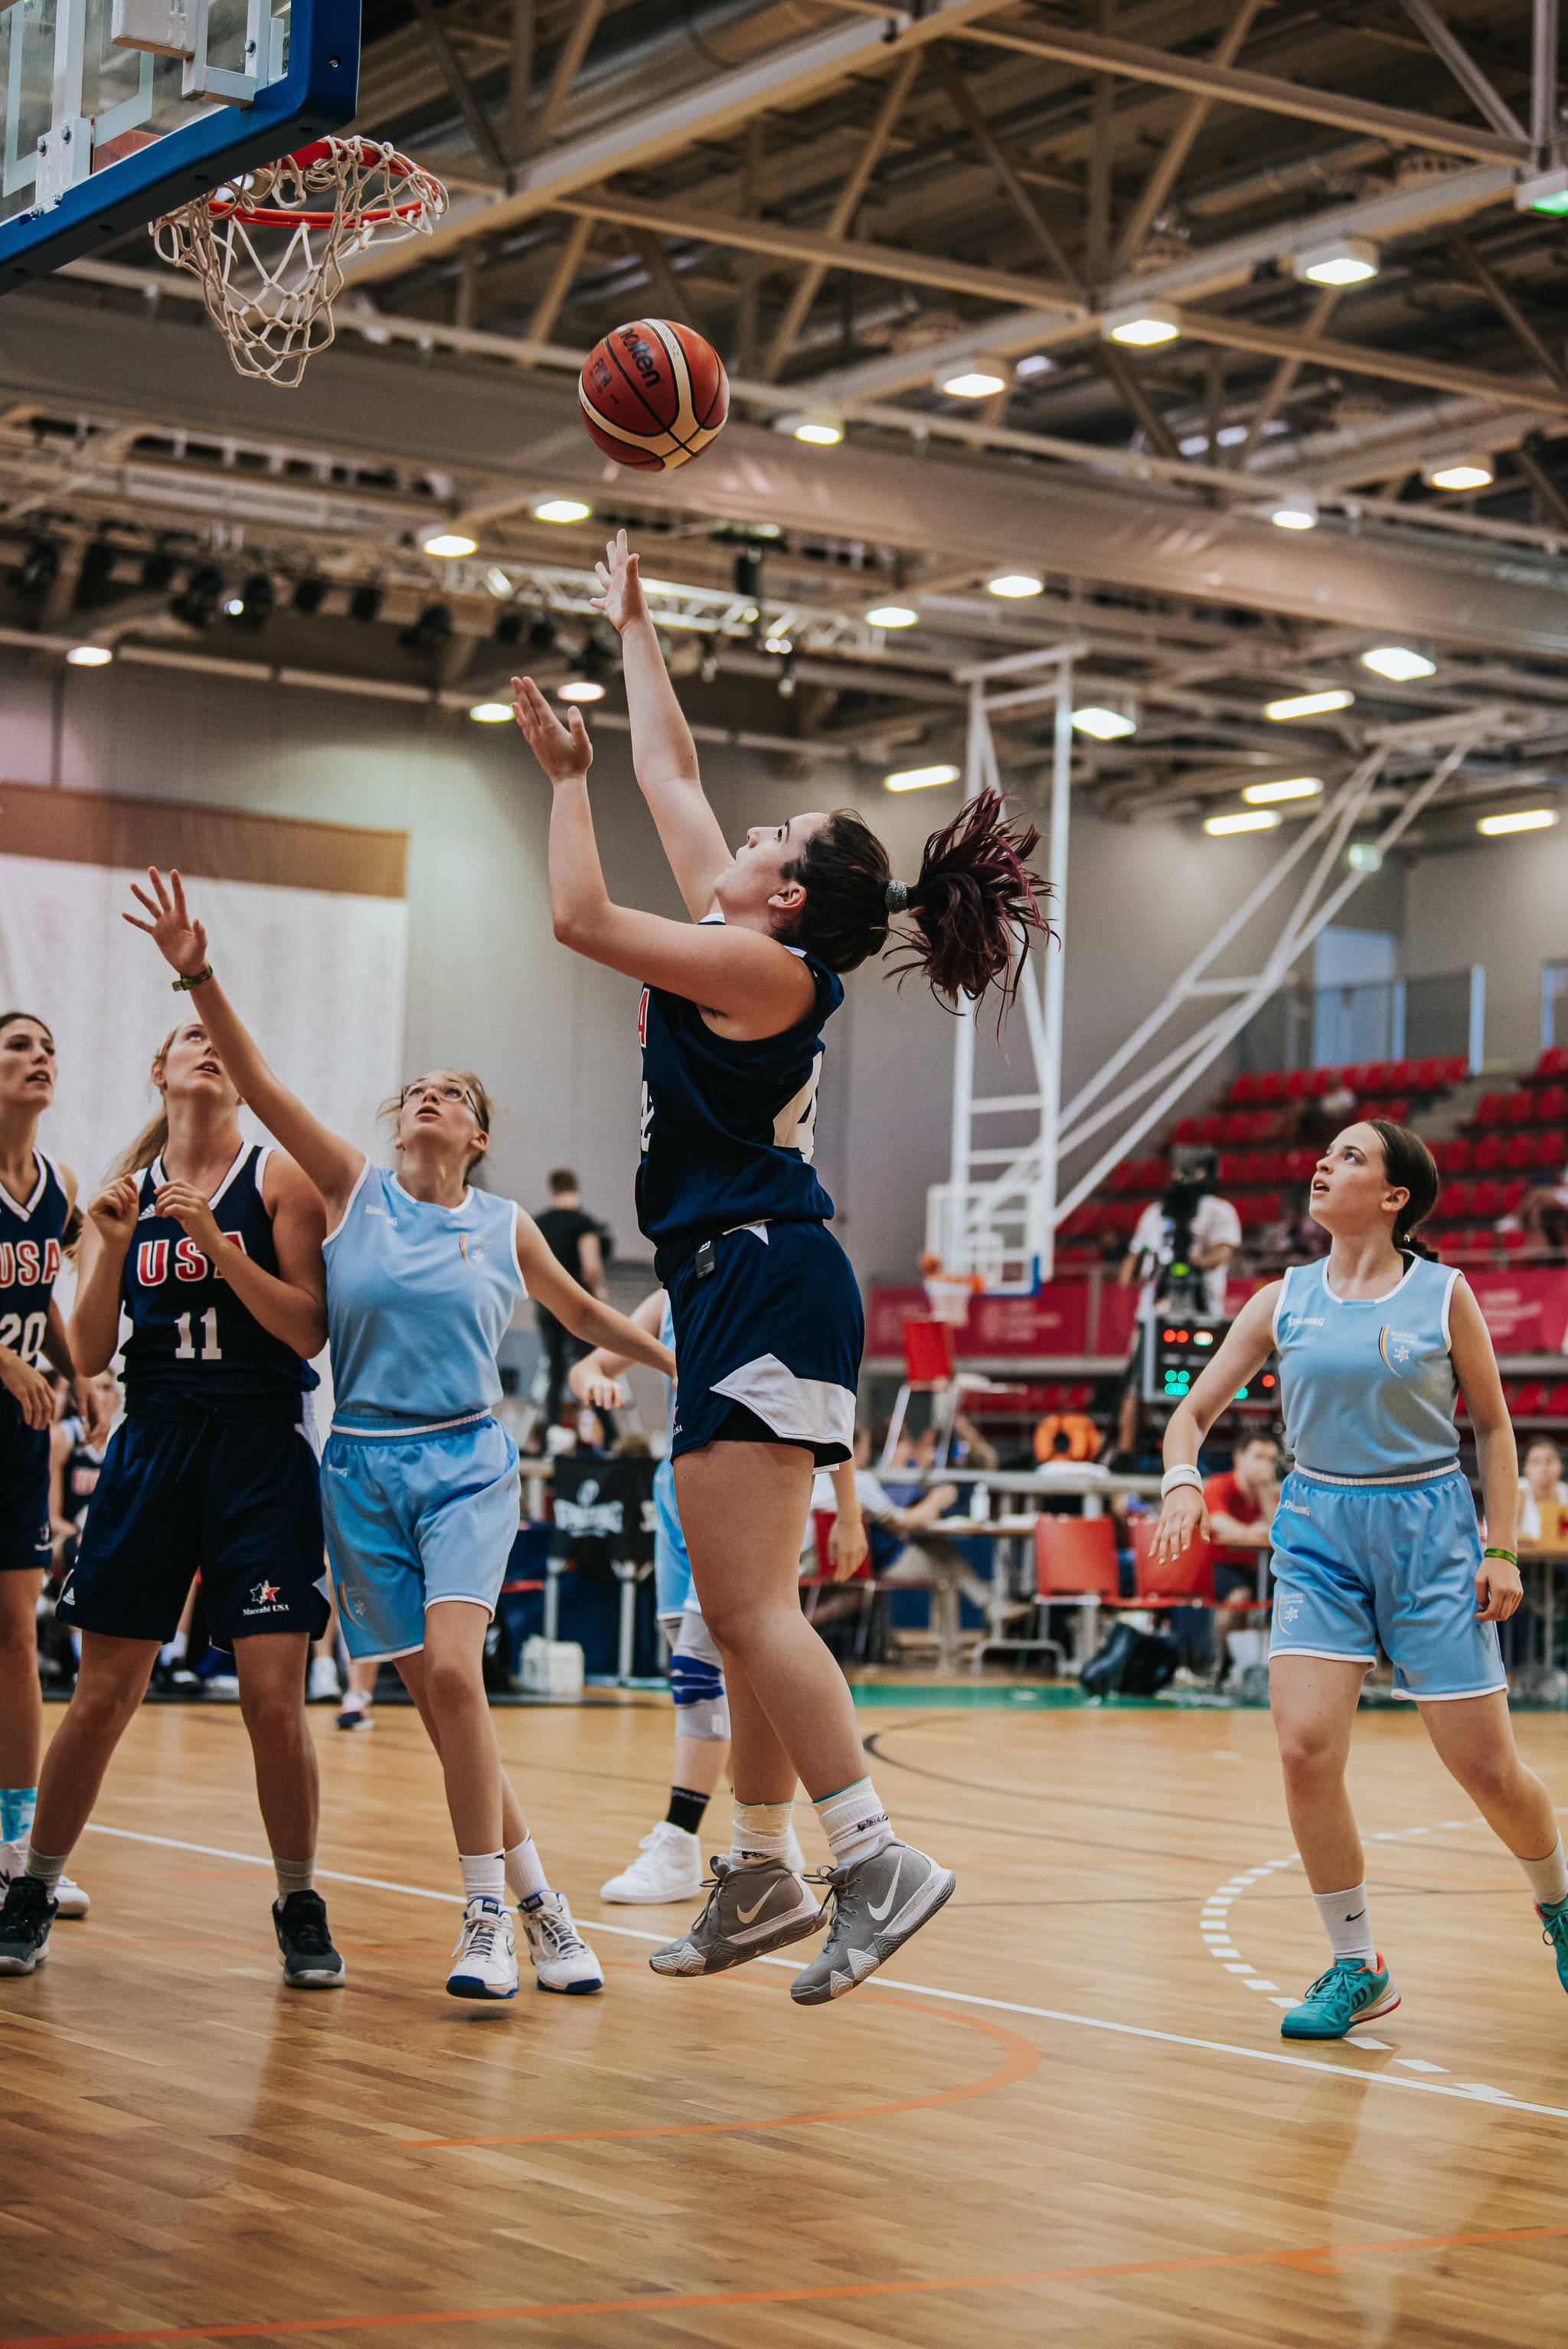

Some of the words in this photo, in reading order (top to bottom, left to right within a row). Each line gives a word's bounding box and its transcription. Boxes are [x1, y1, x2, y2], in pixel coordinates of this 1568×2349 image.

[0, 1312, 47, 1362] 20
[174, 1307, 222, 1361] 11
[243, 1606, 271, 1616] Maccabi
